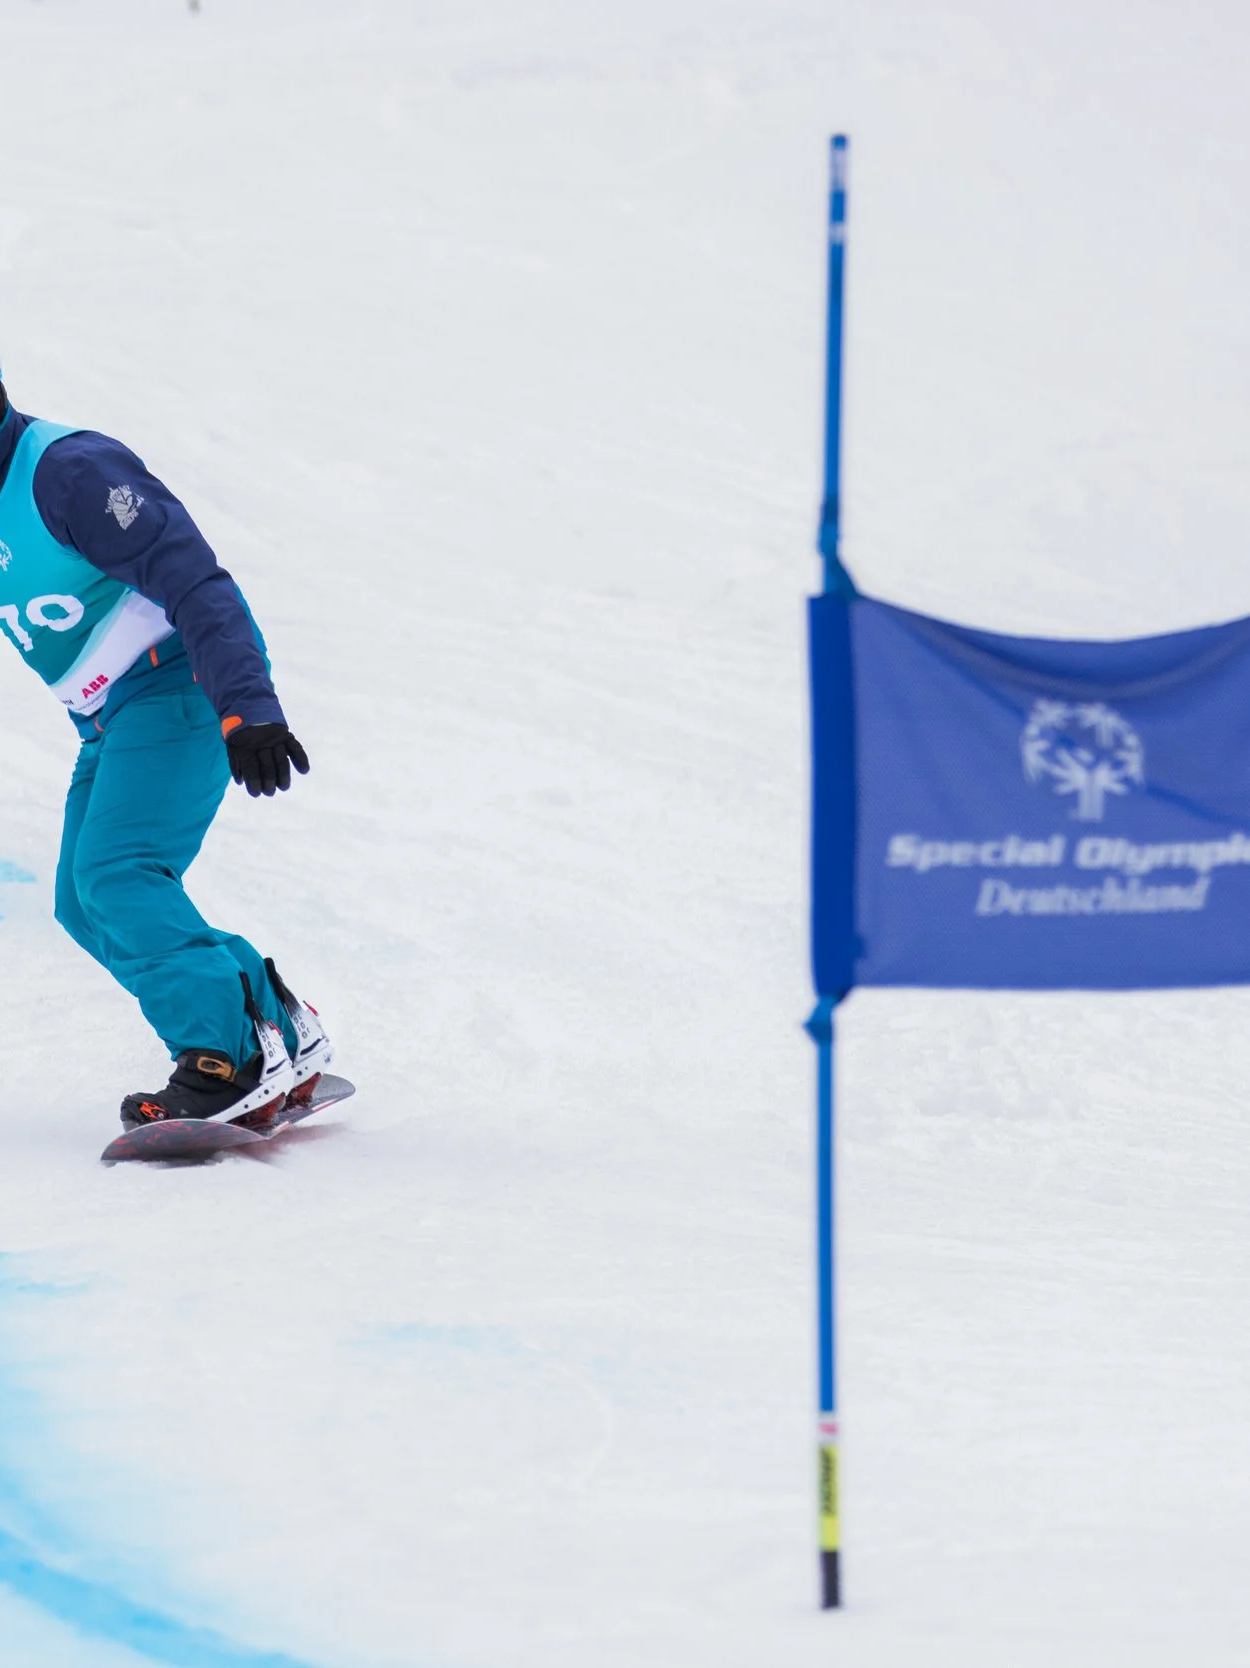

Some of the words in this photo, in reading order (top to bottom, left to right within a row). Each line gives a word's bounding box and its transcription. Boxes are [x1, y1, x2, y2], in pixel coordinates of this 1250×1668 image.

[81, 674, 109, 699] ABB
[885, 833, 1066, 874] Special
[974, 874, 1212, 917] Deutschland
